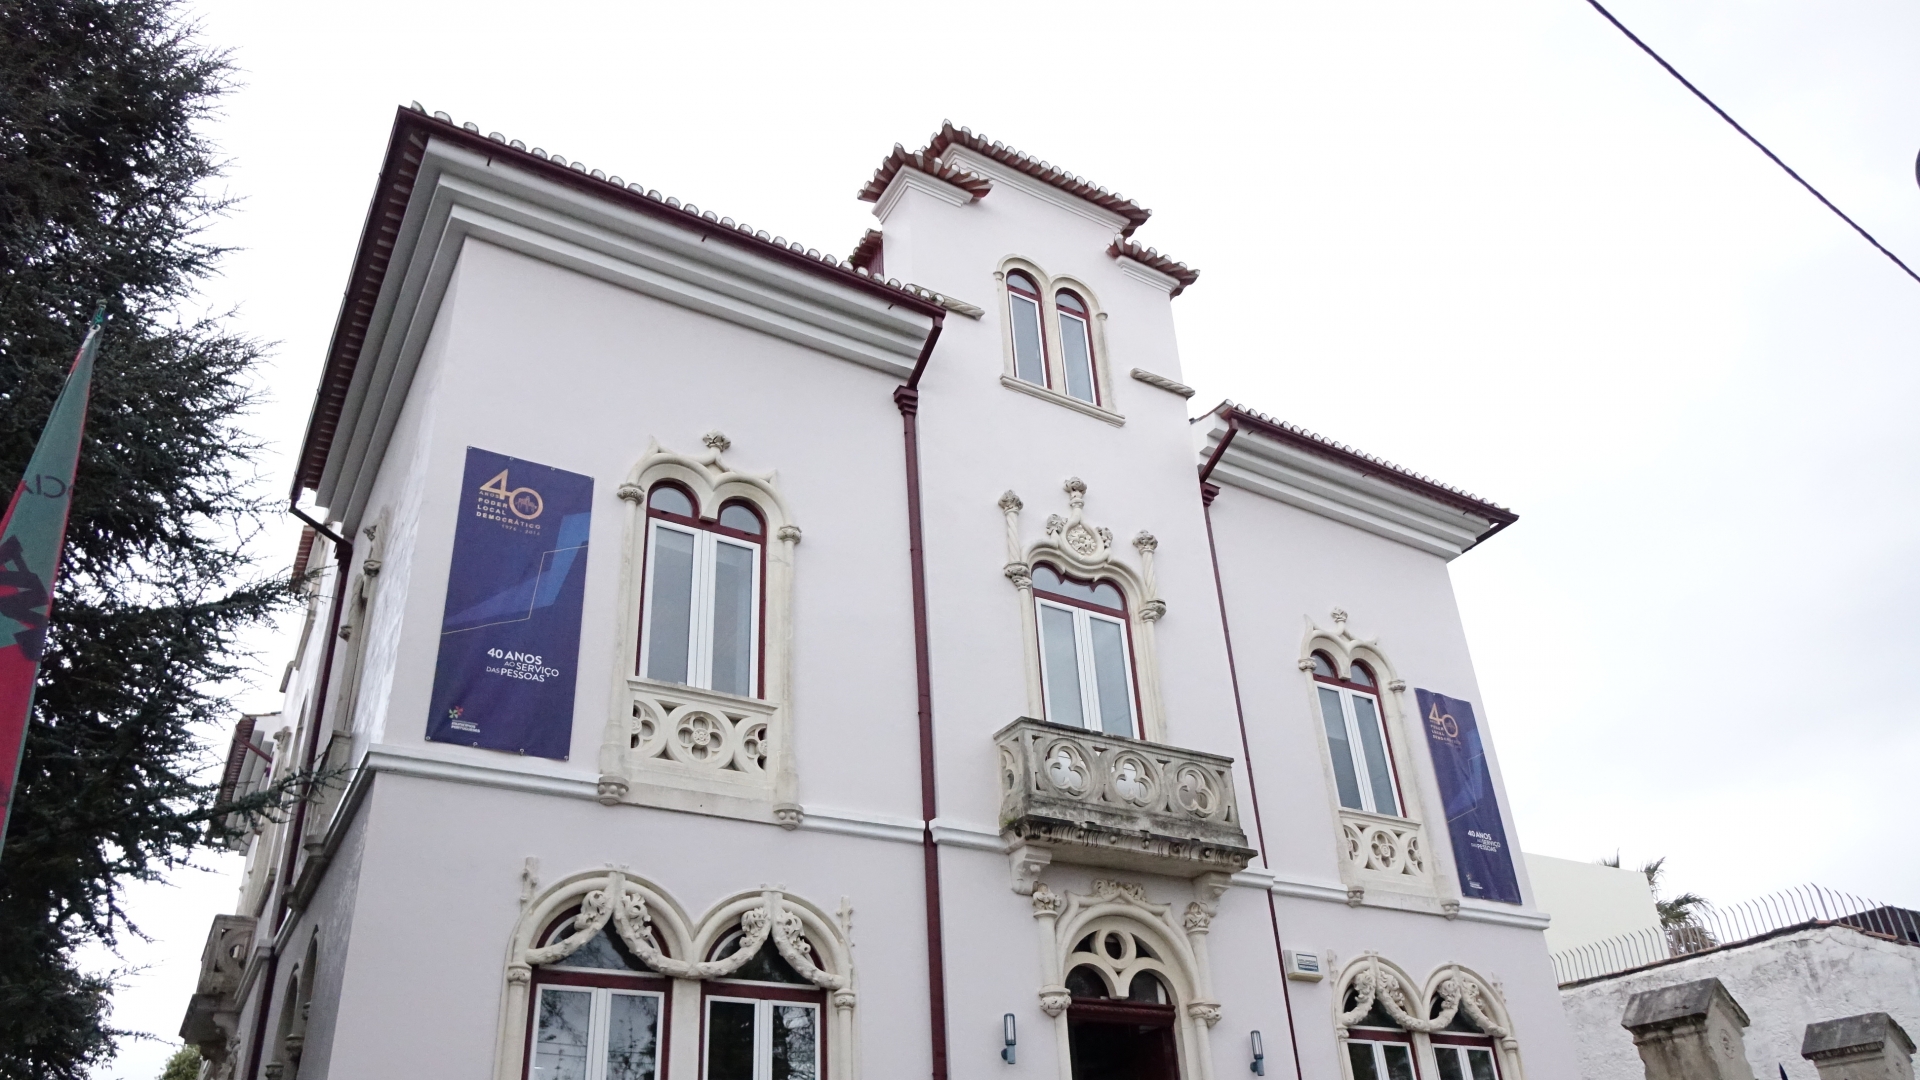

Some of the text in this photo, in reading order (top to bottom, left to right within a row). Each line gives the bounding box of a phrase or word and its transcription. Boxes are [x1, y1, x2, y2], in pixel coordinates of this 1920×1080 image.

[480, 468, 543, 520] 40
[477, 504, 506, 516] LOCAL
[478, 497, 508, 509] PODER
[487, 647, 542, 666] 40 ANOS
[486, 666, 545, 683] DAS PESSOAS
[516, 662, 560, 678] SERVIÇO
[1429, 702, 1458, 738] 40
[1476, 831, 1492, 841] ANOS
